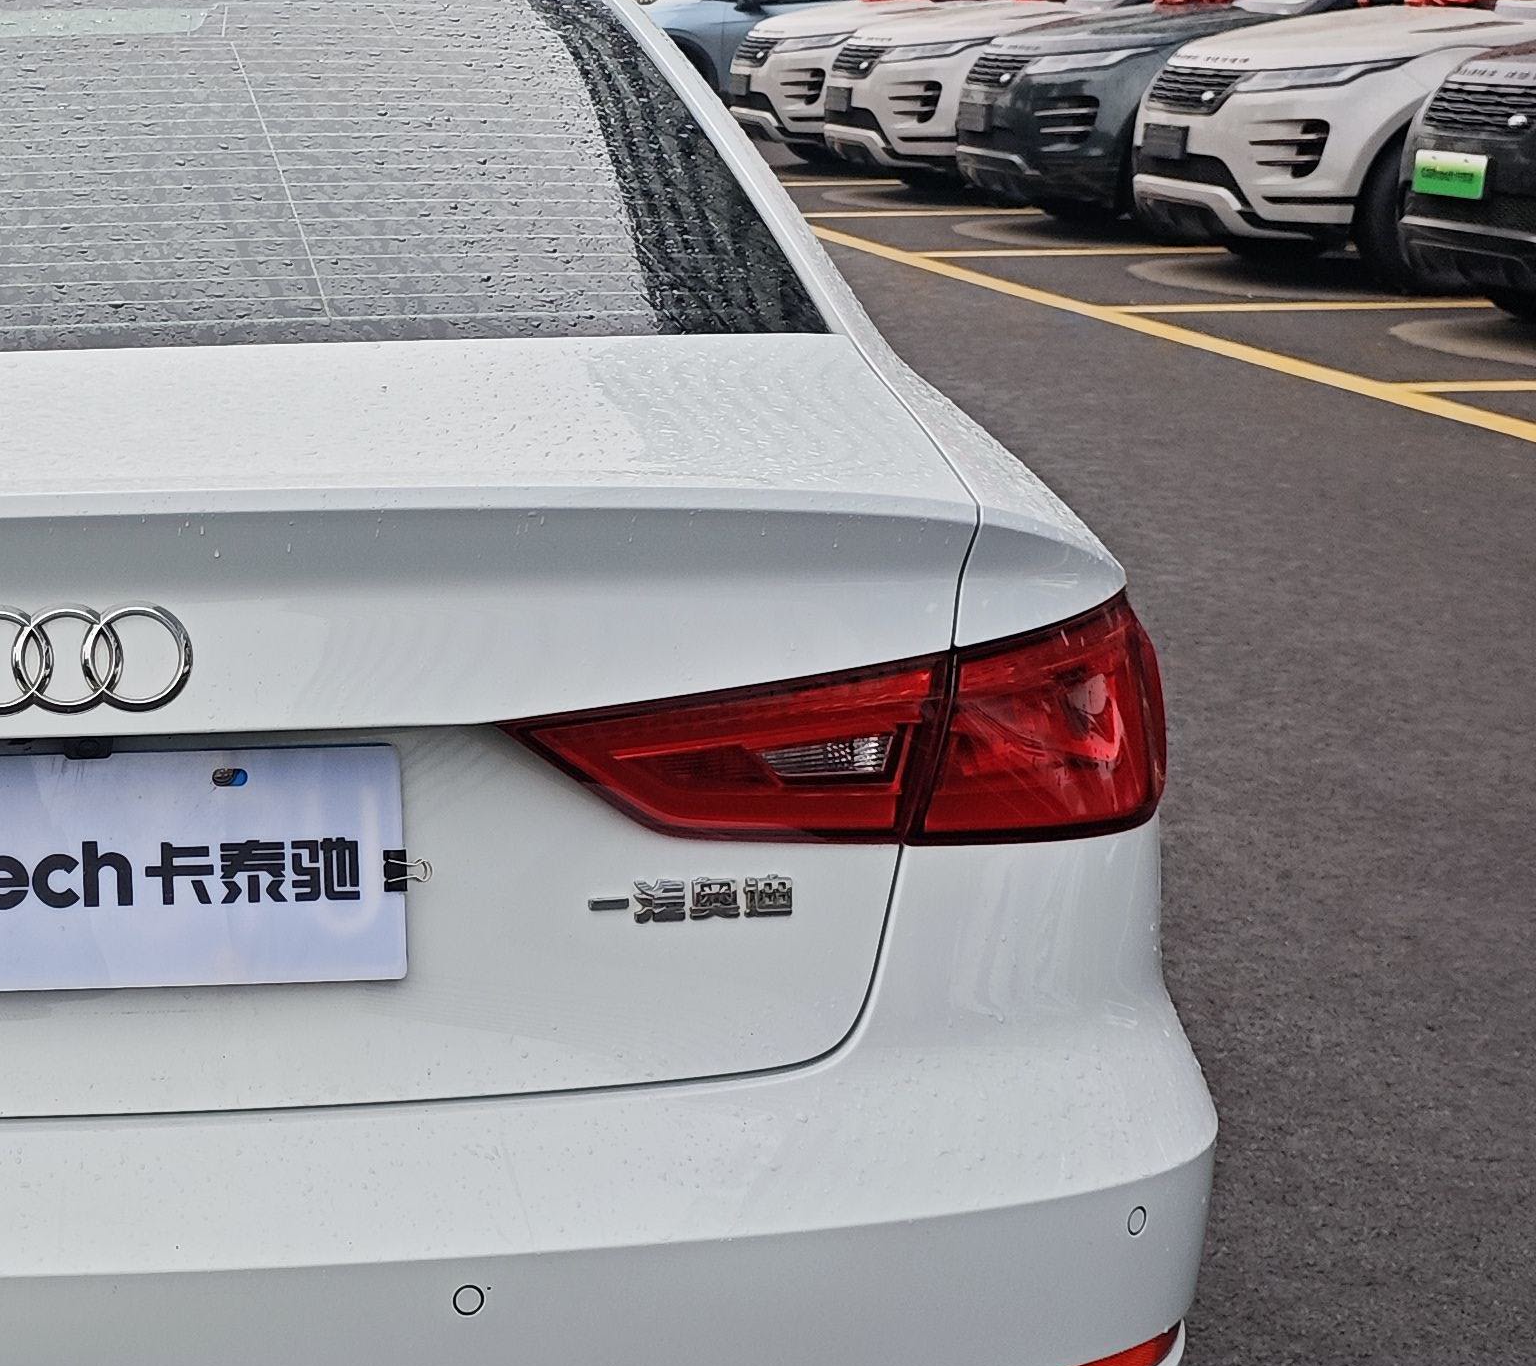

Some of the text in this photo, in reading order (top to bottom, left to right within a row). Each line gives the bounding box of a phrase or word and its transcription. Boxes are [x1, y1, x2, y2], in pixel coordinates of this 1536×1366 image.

[145, 836, 360, 907] 卡泰驰
[587, 873, 793, 924] 一汽奥迪
